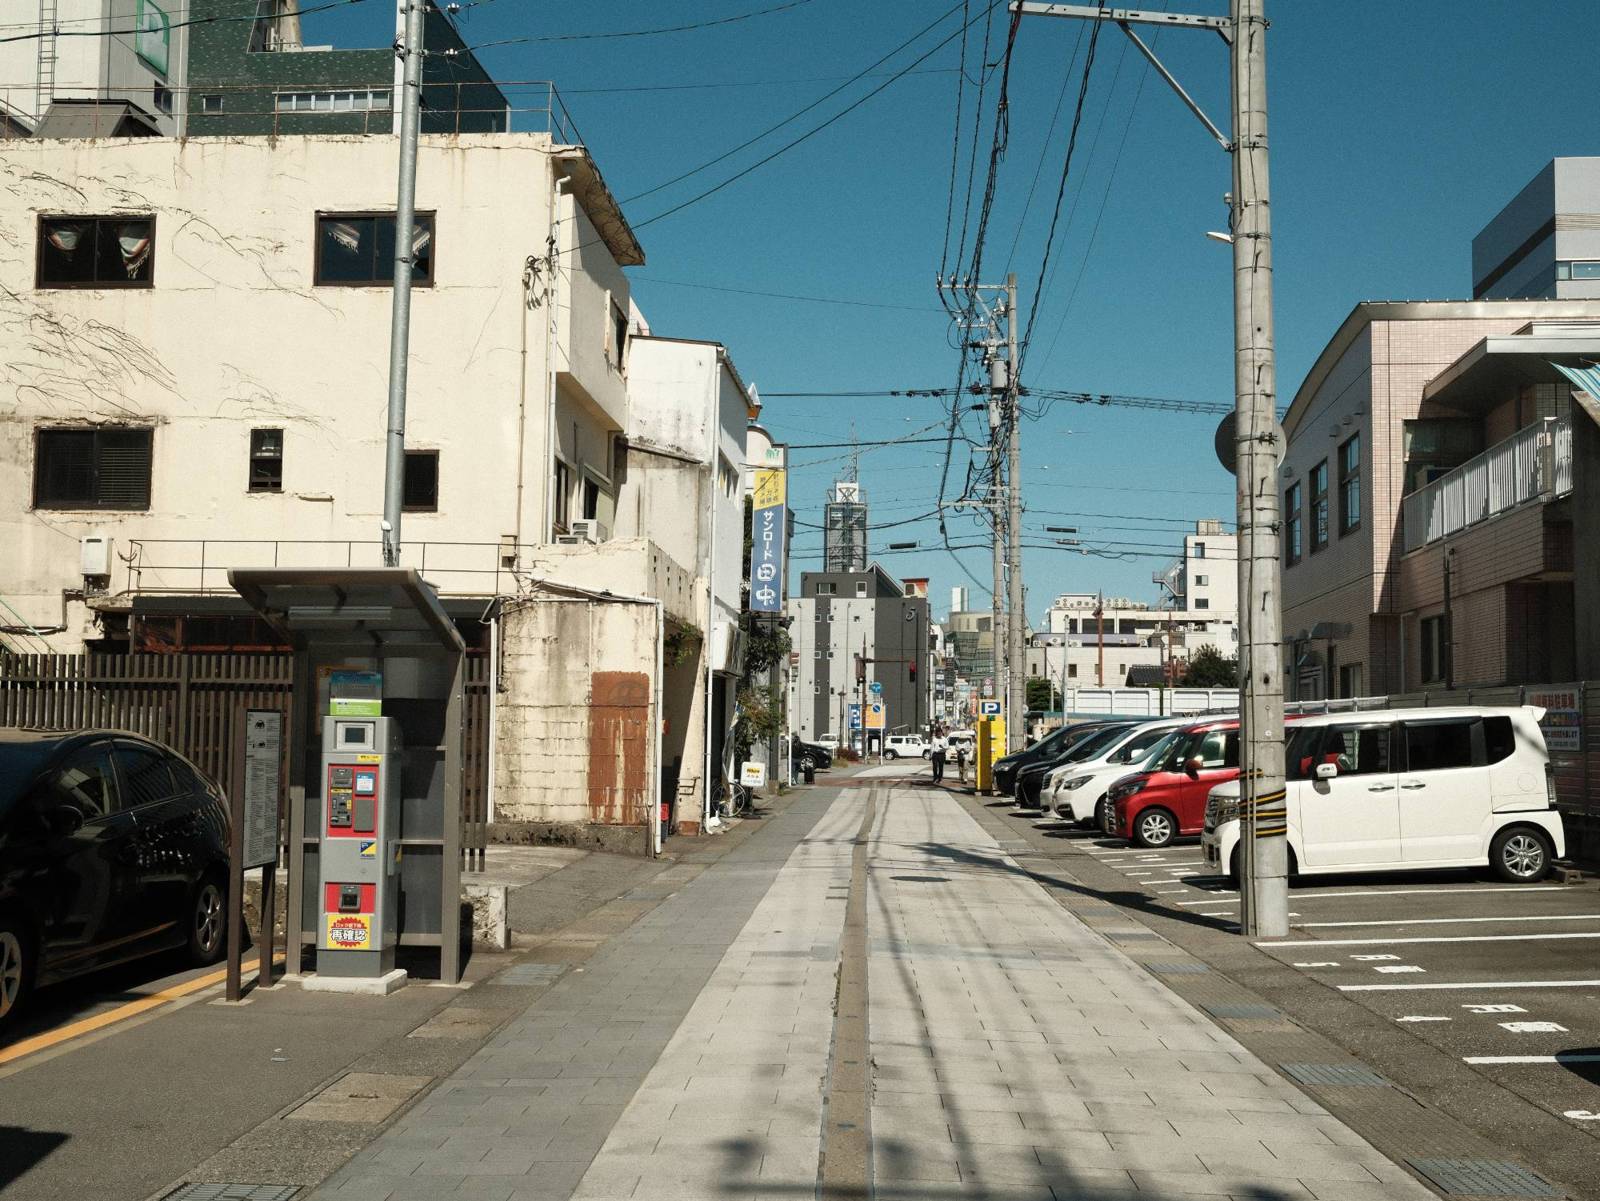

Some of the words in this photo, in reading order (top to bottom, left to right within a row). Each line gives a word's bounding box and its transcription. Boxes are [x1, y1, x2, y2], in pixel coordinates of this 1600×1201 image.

[756, 510, 776, 606] サンロード田中
[984, 702, 998, 714] P
[331, 929, 367, 941] 再確認
